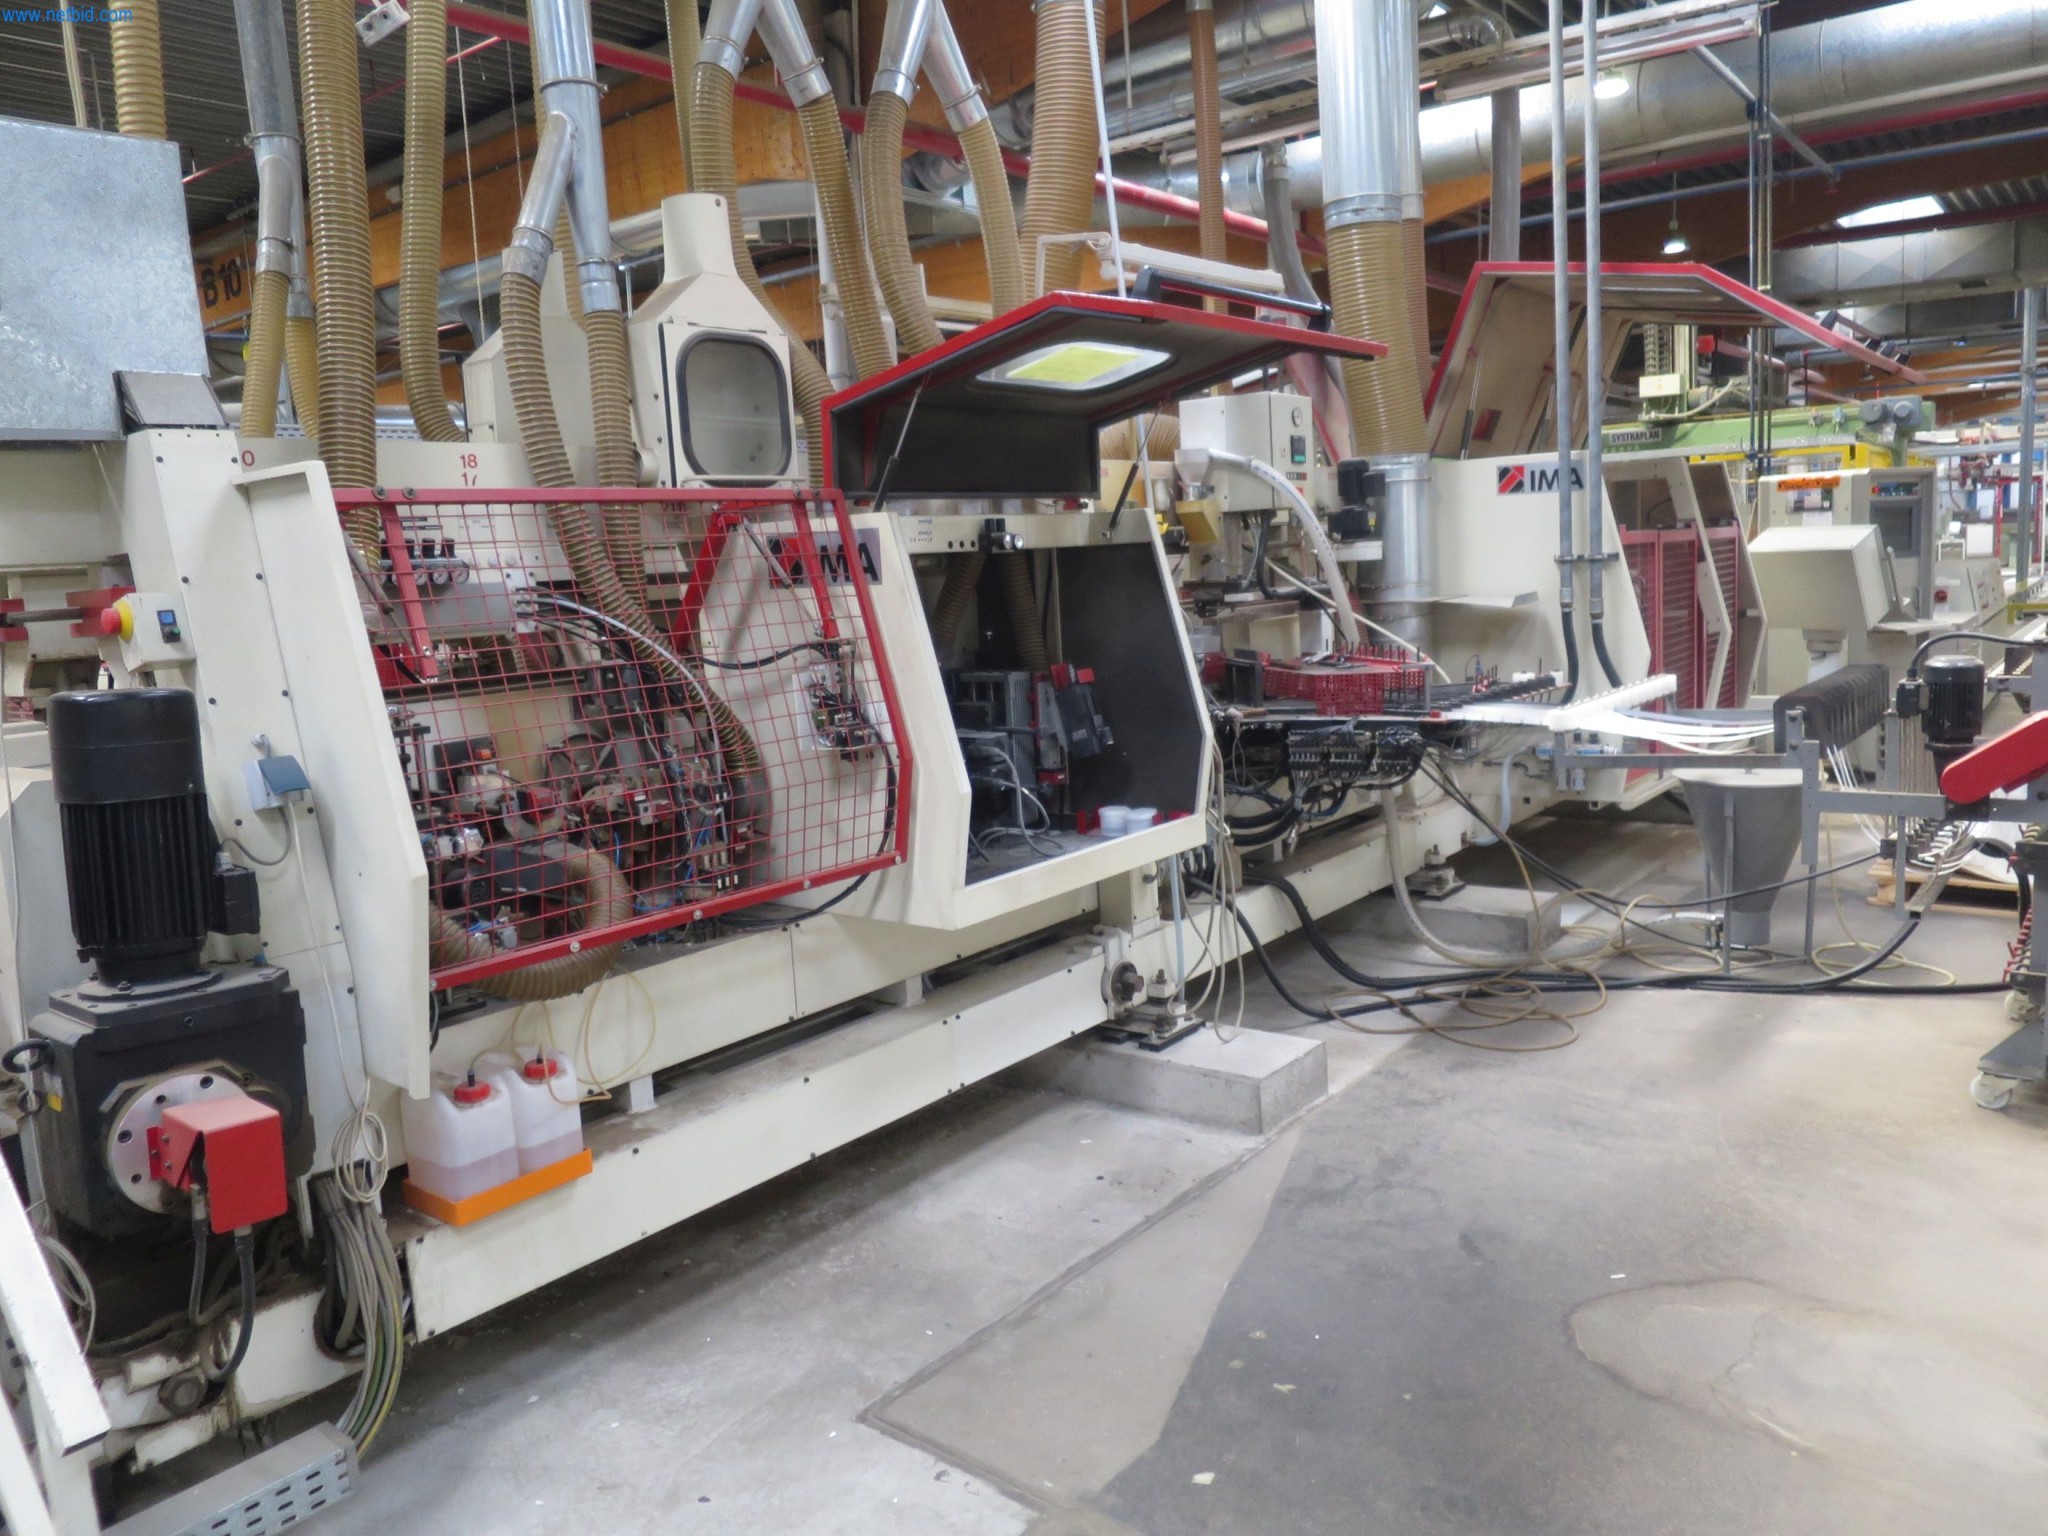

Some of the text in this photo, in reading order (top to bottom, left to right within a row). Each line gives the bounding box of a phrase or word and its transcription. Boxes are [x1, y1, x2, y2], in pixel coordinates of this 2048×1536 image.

[1611, 430, 1661, 443] SYSTRAPLAN
[460, 453, 478, 469] 18
[1530, 467, 1584, 491] IMA
[819, 542, 880, 583] MA
